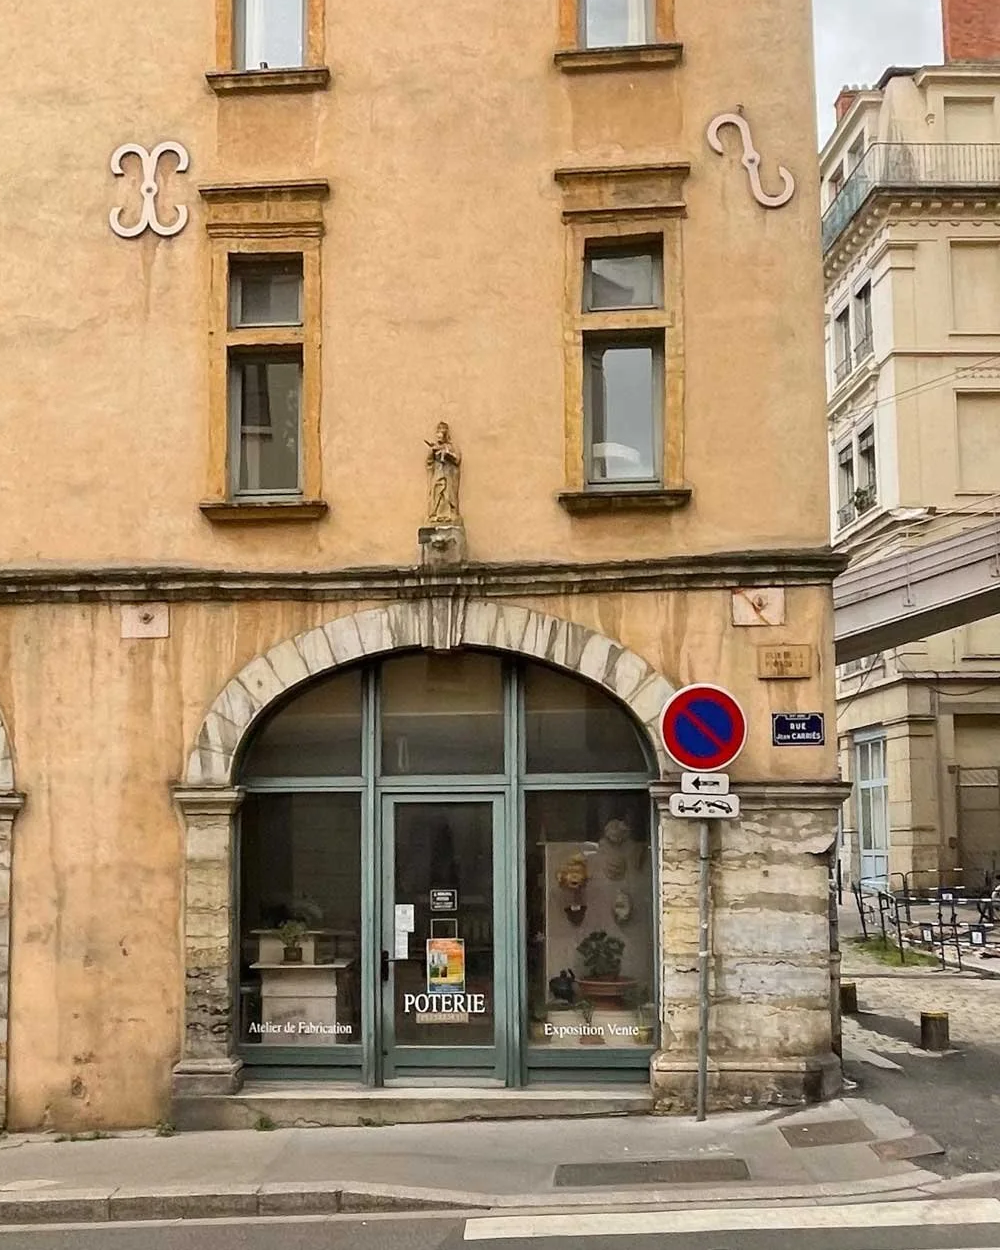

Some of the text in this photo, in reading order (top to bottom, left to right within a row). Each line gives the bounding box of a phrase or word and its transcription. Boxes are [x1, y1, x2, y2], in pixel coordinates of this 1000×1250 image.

[789, 722, 807, 730] RUE
[403, 993, 486, 1013] POTERIE
[248, 1021, 353, 1034] Atelier de Fabrication
[543, 1023, 640, 1038] Exposition Vente
